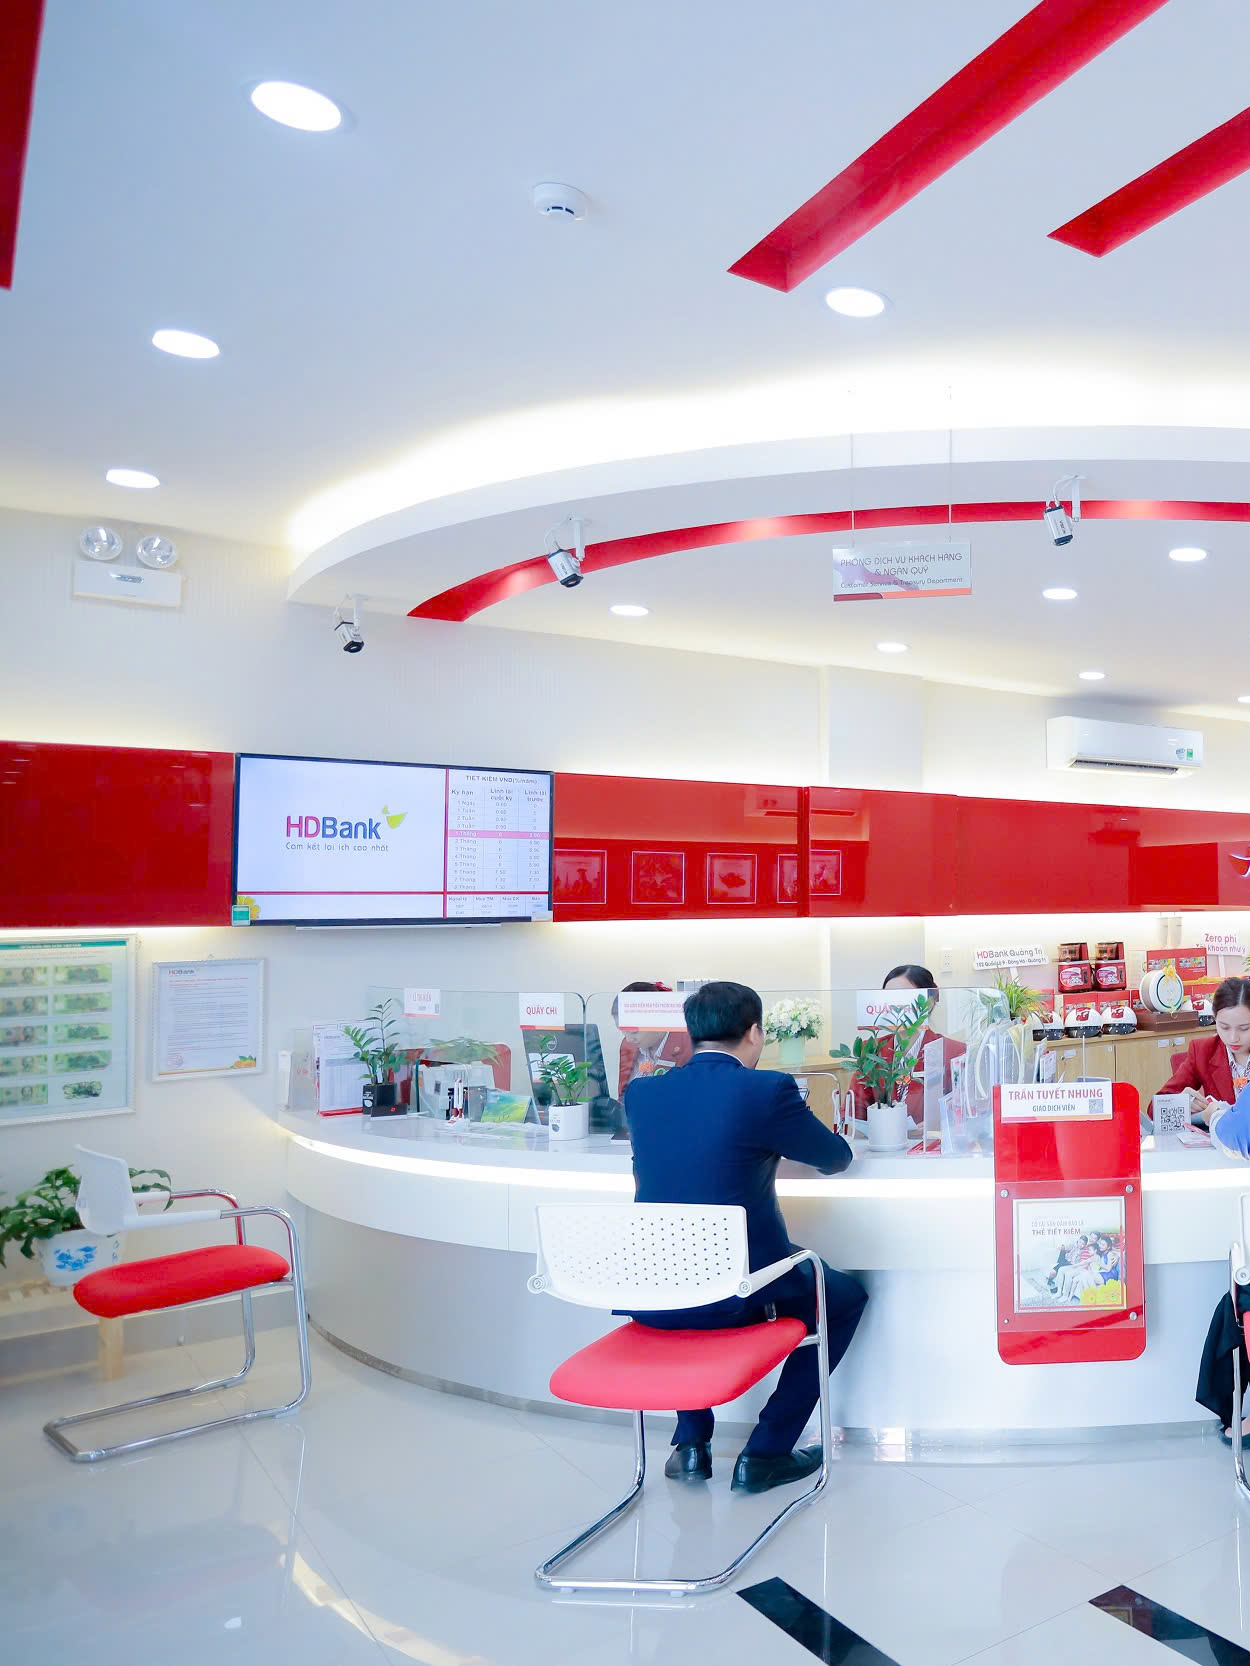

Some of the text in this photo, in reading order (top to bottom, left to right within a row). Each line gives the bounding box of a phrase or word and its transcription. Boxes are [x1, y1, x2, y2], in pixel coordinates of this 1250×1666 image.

[286, 815, 381, 840] HDBank
[285, 841, 303, 850] Cam
[353, 844, 367, 852] cao
[1205, 933, 1222, 942] Zero
[976, 949, 1008, 959] HDBank
[545, 1006, 557, 1015] CHI
[1068, 1088, 1103, 1099] NHUNG
